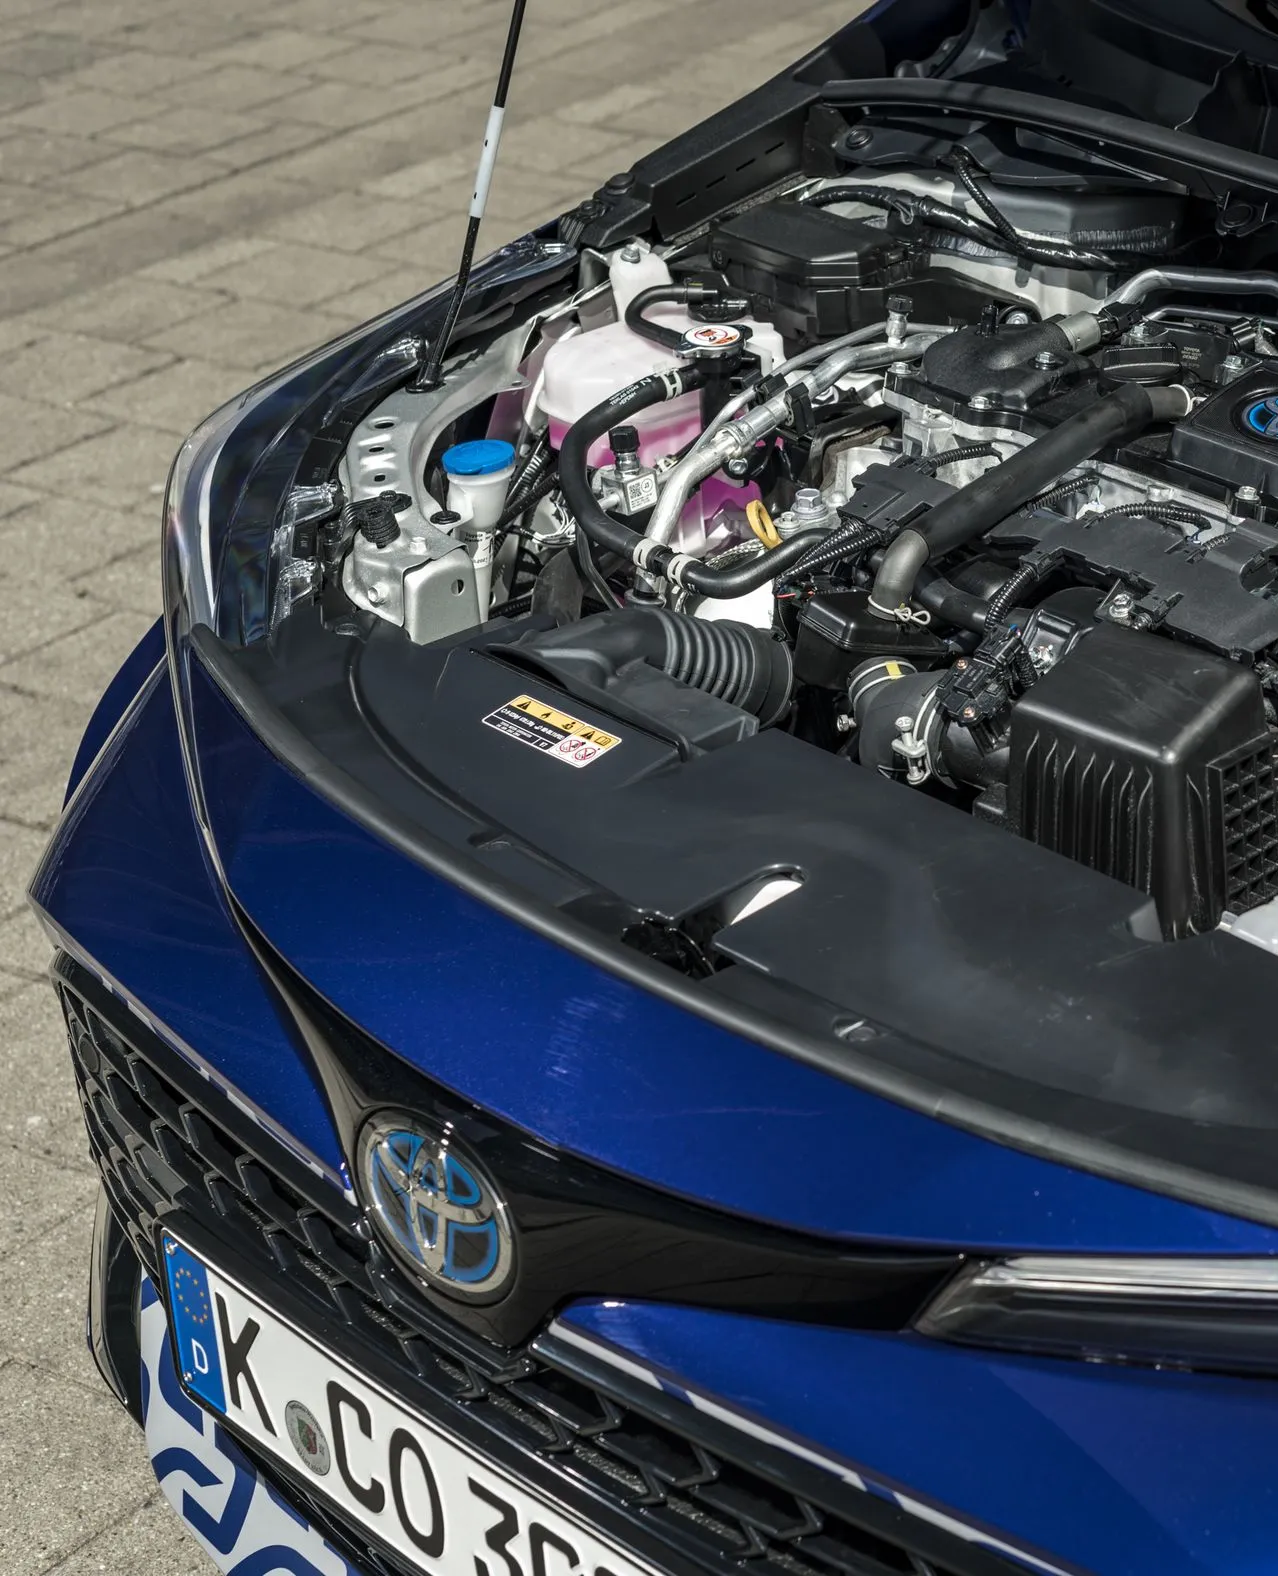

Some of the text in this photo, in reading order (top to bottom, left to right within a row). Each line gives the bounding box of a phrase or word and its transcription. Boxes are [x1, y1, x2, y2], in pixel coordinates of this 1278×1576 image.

[191, 1339, 209, 1375] D
[215, 1291, 277, 1437] K
[326, 1380, 444, 1558] CO
